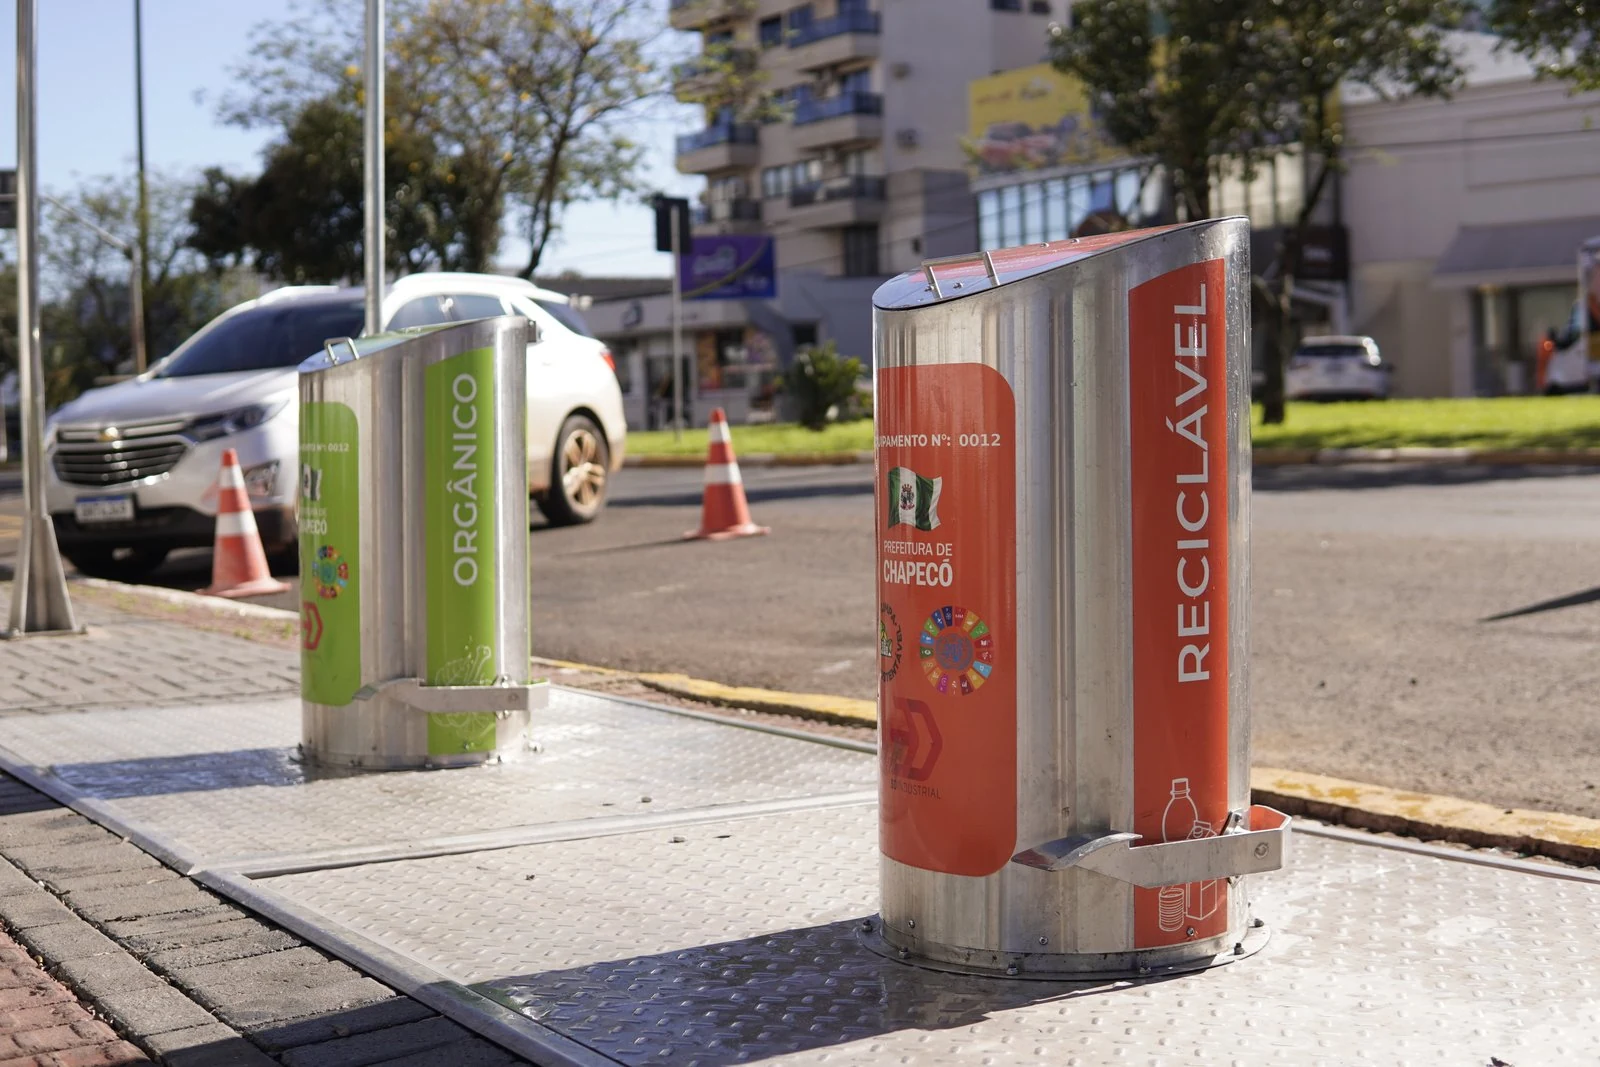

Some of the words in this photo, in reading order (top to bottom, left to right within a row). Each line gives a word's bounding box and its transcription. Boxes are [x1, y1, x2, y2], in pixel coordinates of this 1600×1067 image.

[959, 433, 1001, 447] 0012
[446, 373, 478, 586] ORGÂNICO
[1165, 283, 1211, 683] RECICLÁVEL
[884, 540, 934, 556] PREFEITURA
[936, 543, 953, 556] DE
[883, 558, 954, 588] CHAPECÓ
